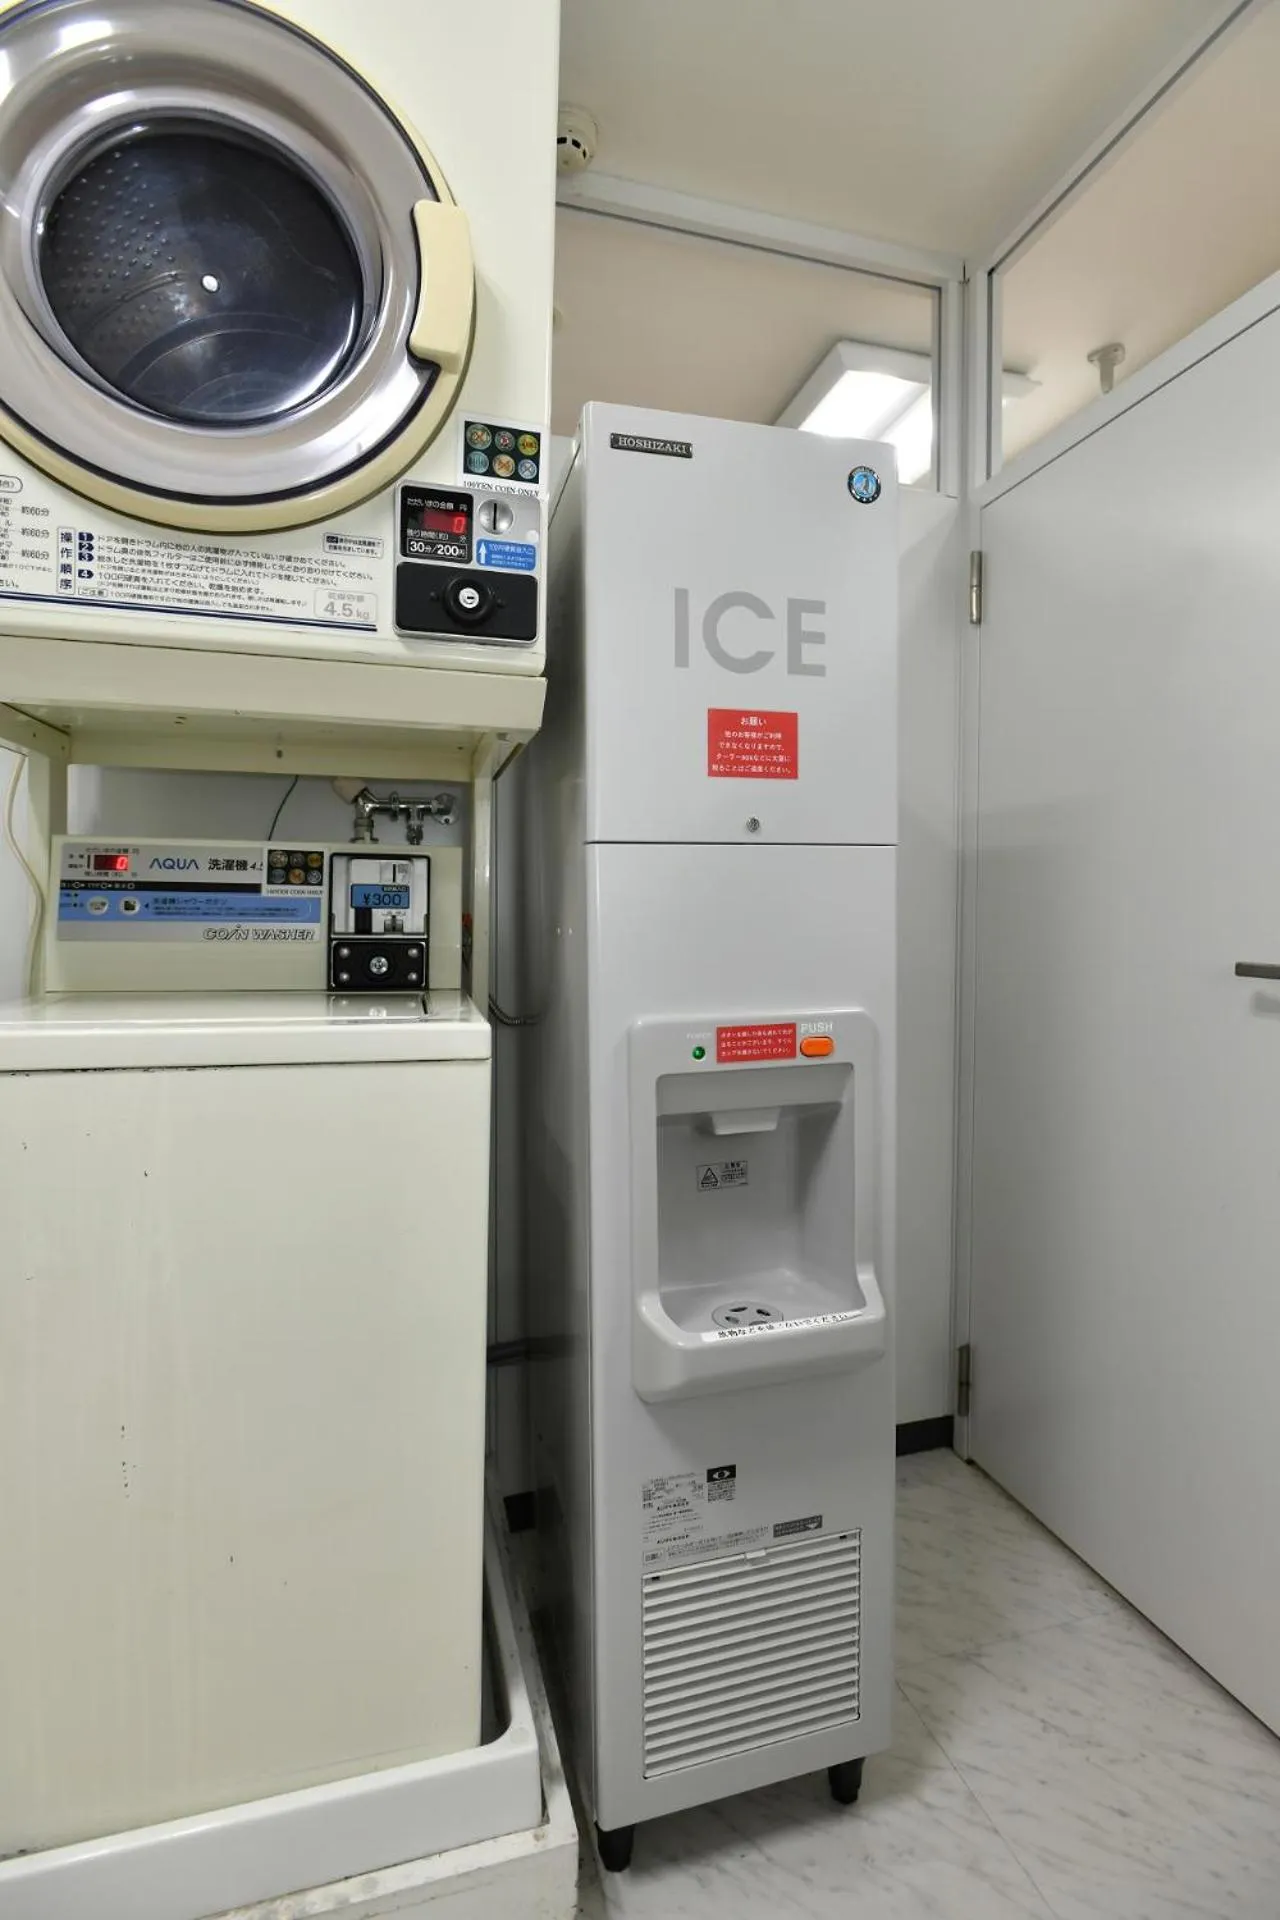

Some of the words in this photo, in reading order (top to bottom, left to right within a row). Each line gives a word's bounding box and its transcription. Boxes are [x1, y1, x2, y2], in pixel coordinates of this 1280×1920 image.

[618, 437, 688, 454] HOSHIZAKI
[494, 484, 516, 494] COIN
[517, 488, 540, 497] ONLY
[452, 516, 467, 534] 0
[323, 600, 354, 618] 4.5
[356, 607, 371, 620] kg
[674, 587, 827, 678] ICE
[740, 715, 767, 727] お願い
[116, 856, 129, 870] 0
[149, 857, 200, 870] AQUA
[208, 858, 248, 872] 洗濯機
[362, 892, 402, 906] ¥300
[251, 928, 316, 941] WASHER
[800, 1021, 834, 1034] PUSH
